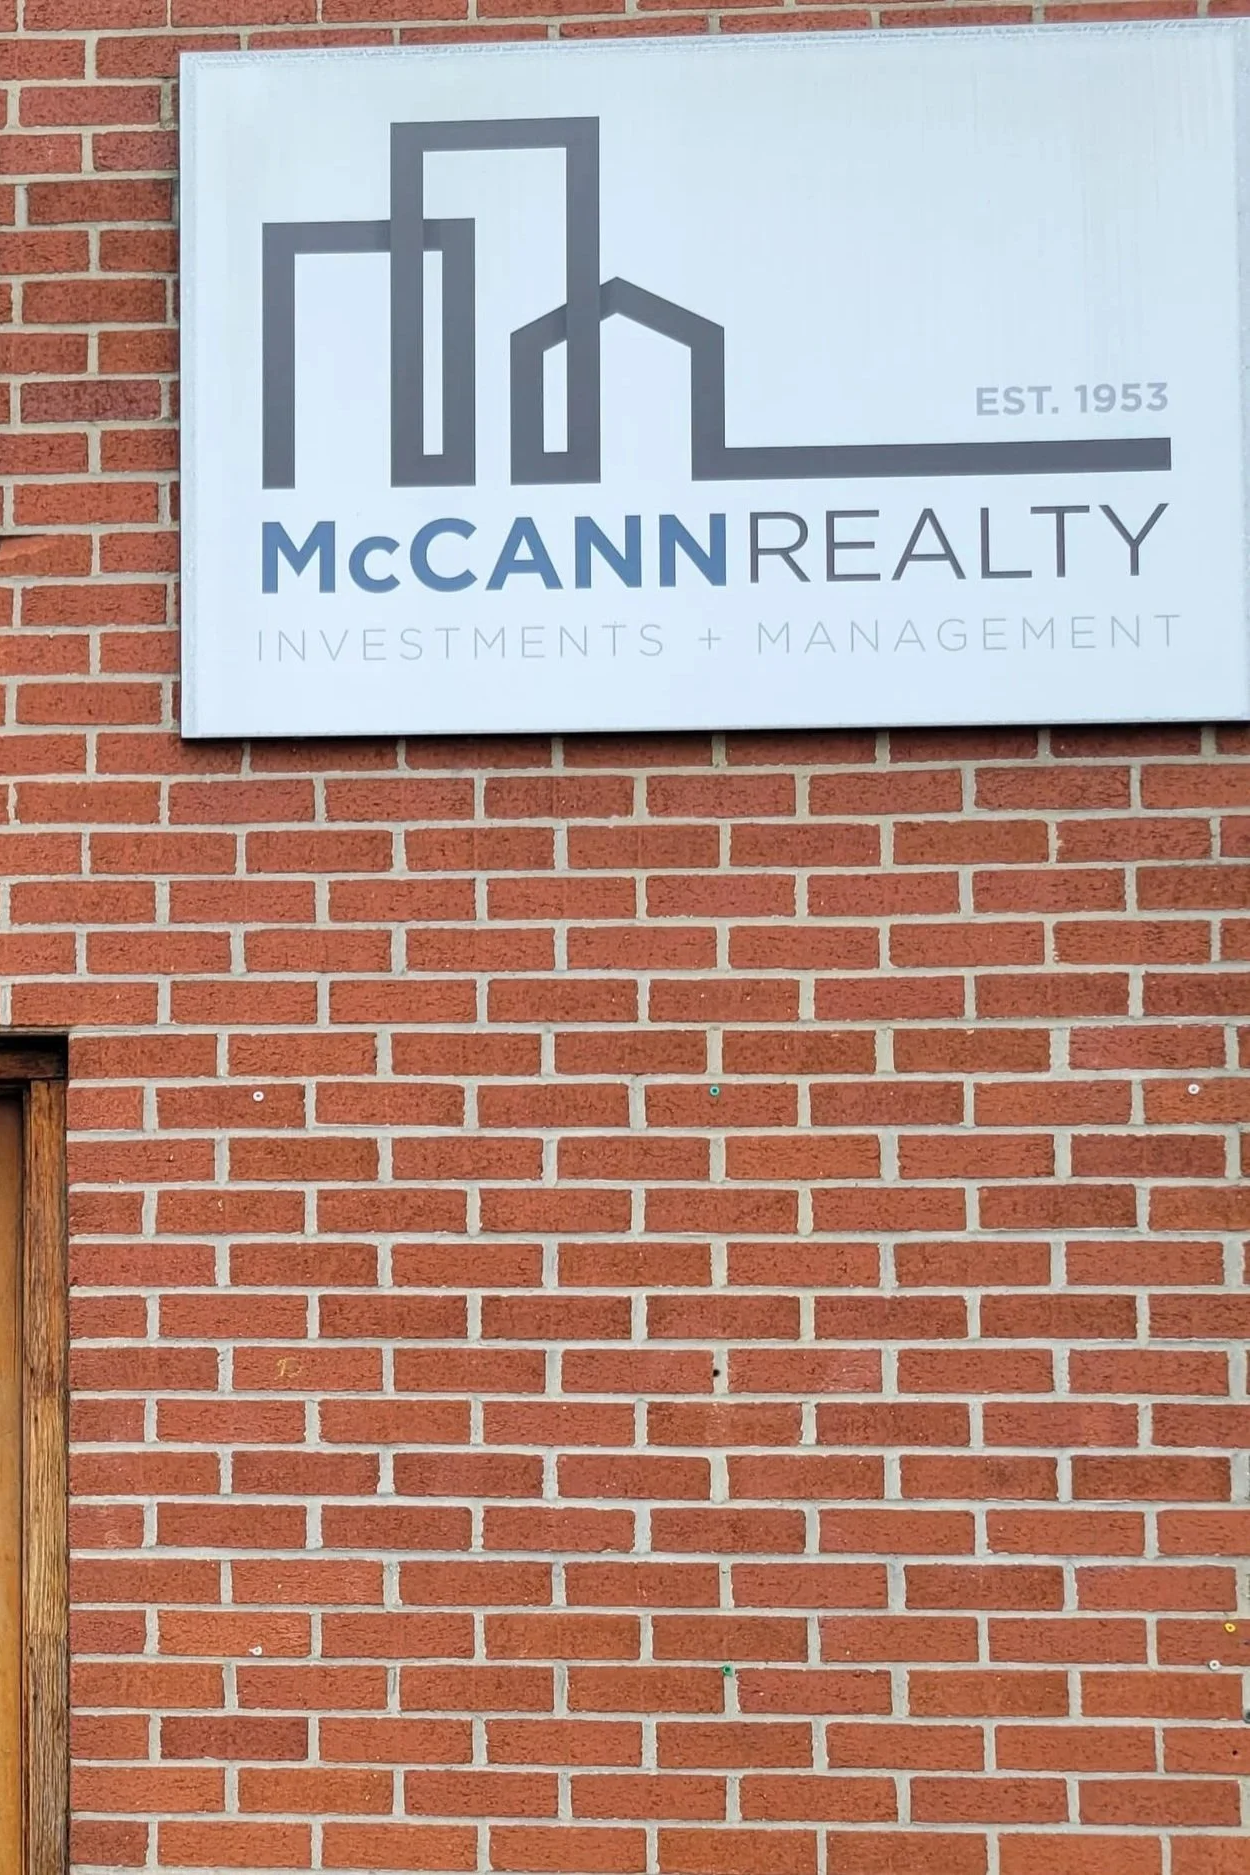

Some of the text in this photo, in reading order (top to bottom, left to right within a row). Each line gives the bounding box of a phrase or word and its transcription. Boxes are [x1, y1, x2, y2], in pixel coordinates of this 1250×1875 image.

[976, 382, 1168, 416] EST. 1953
[258, 623, 664, 662] INVESTMENTS
[757, 614, 1181, 654] MANAGEMENT
